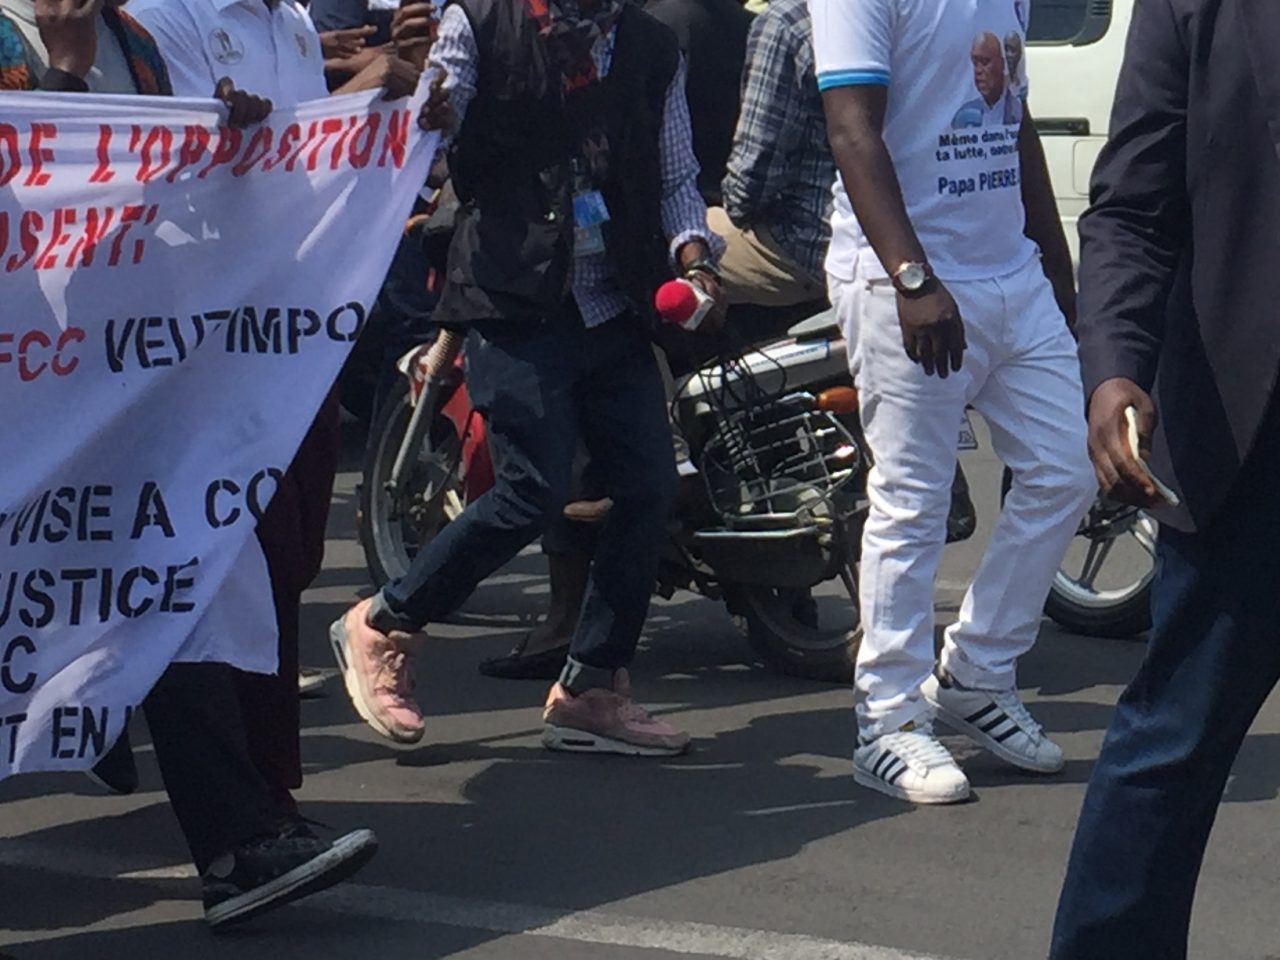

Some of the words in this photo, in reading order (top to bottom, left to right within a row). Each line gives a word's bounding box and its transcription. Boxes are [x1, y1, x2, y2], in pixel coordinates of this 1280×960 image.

[89, 110, 411, 183] L'OPPOSITION
[936, 149, 950, 161] ta
[938, 176, 976, 198] Papa
[979, 168, 1017, 191] PIERRE
[130, 480, 176, 539] A
[52, 705, 109, 759] EN
